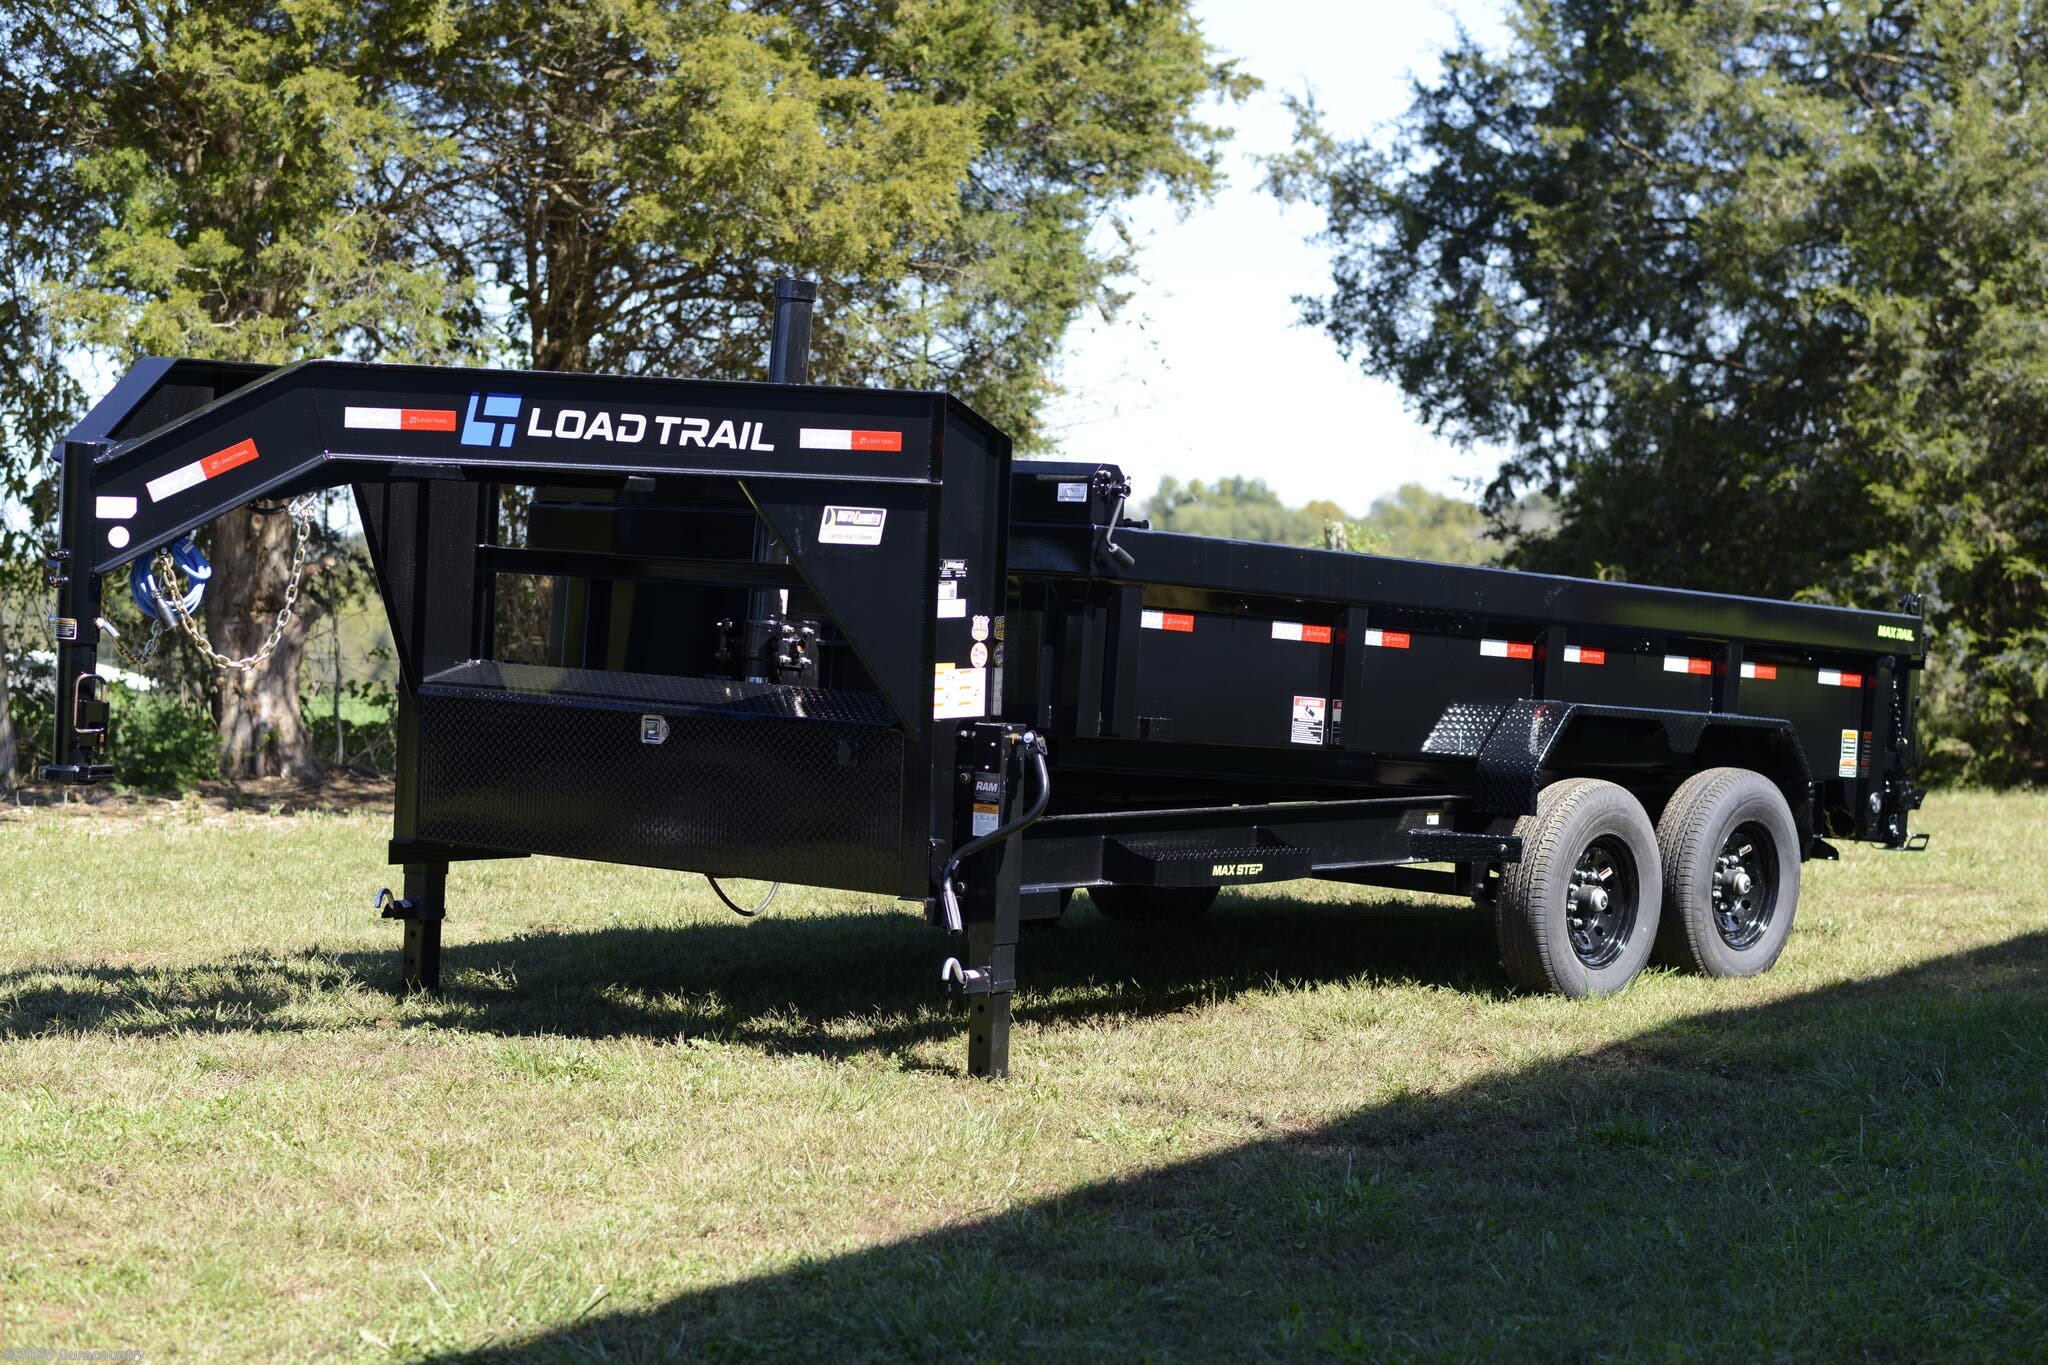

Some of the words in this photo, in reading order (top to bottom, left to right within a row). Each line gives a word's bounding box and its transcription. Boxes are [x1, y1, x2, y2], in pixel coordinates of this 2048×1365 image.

[527, 407, 646, 442] LOAD
[655, 416, 775, 451] TRAIL
[976, 781, 998, 793] RAM
[1212, 864, 1236, 876] MAX
[1236, 863, 1264, 876] STEP
